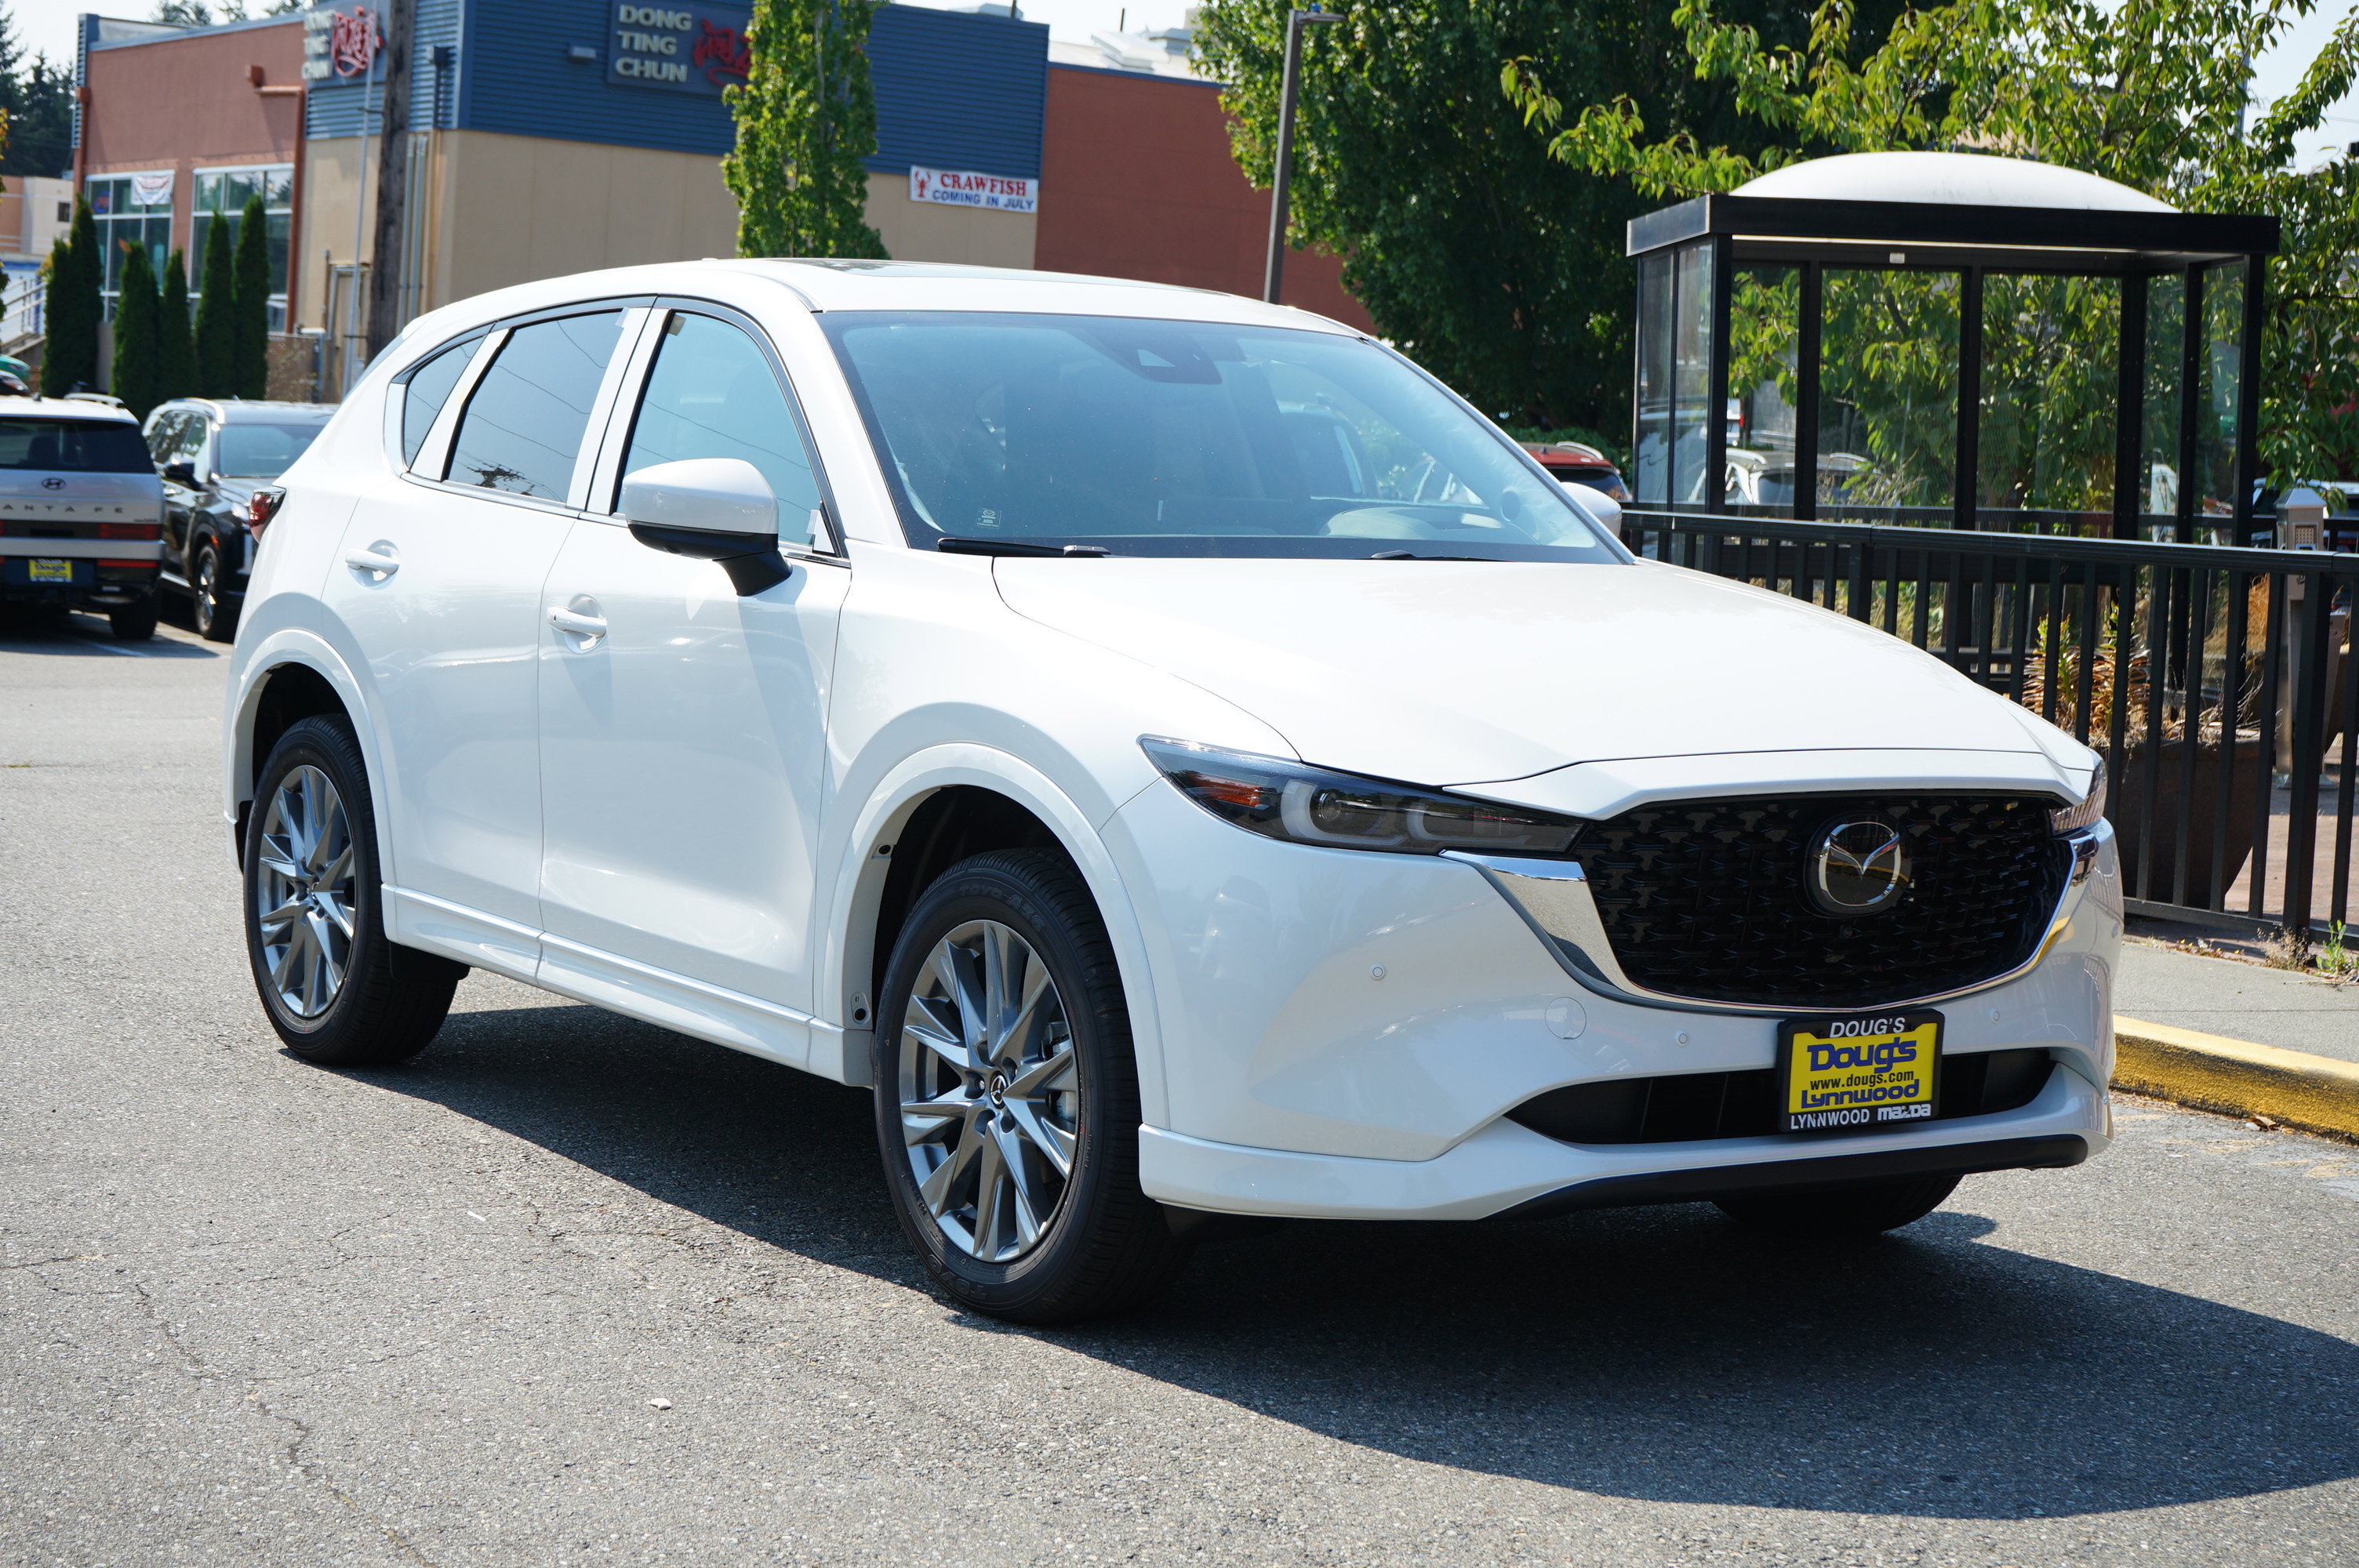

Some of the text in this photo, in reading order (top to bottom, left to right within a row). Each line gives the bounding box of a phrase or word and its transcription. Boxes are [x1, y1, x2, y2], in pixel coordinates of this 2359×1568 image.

[619, 4, 692, 31] DONG
[616, 31, 678, 56] TING
[615, 56, 688, 82] CHUN
[940, 173, 1027, 196] CRAWFISH
[932, 190, 1034, 210] COMING IN JULY
[1829, 1017, 1906, 1039] DOUG'S
[1807, 1036, 1917, 1074] Doug's
[1810, 1070, 1914, 1091] www.dougs.com
[1801, 1078, 1920, 1109] Lynnwood
[1790, 1109, 1870, 1130] LYNNWOOD
